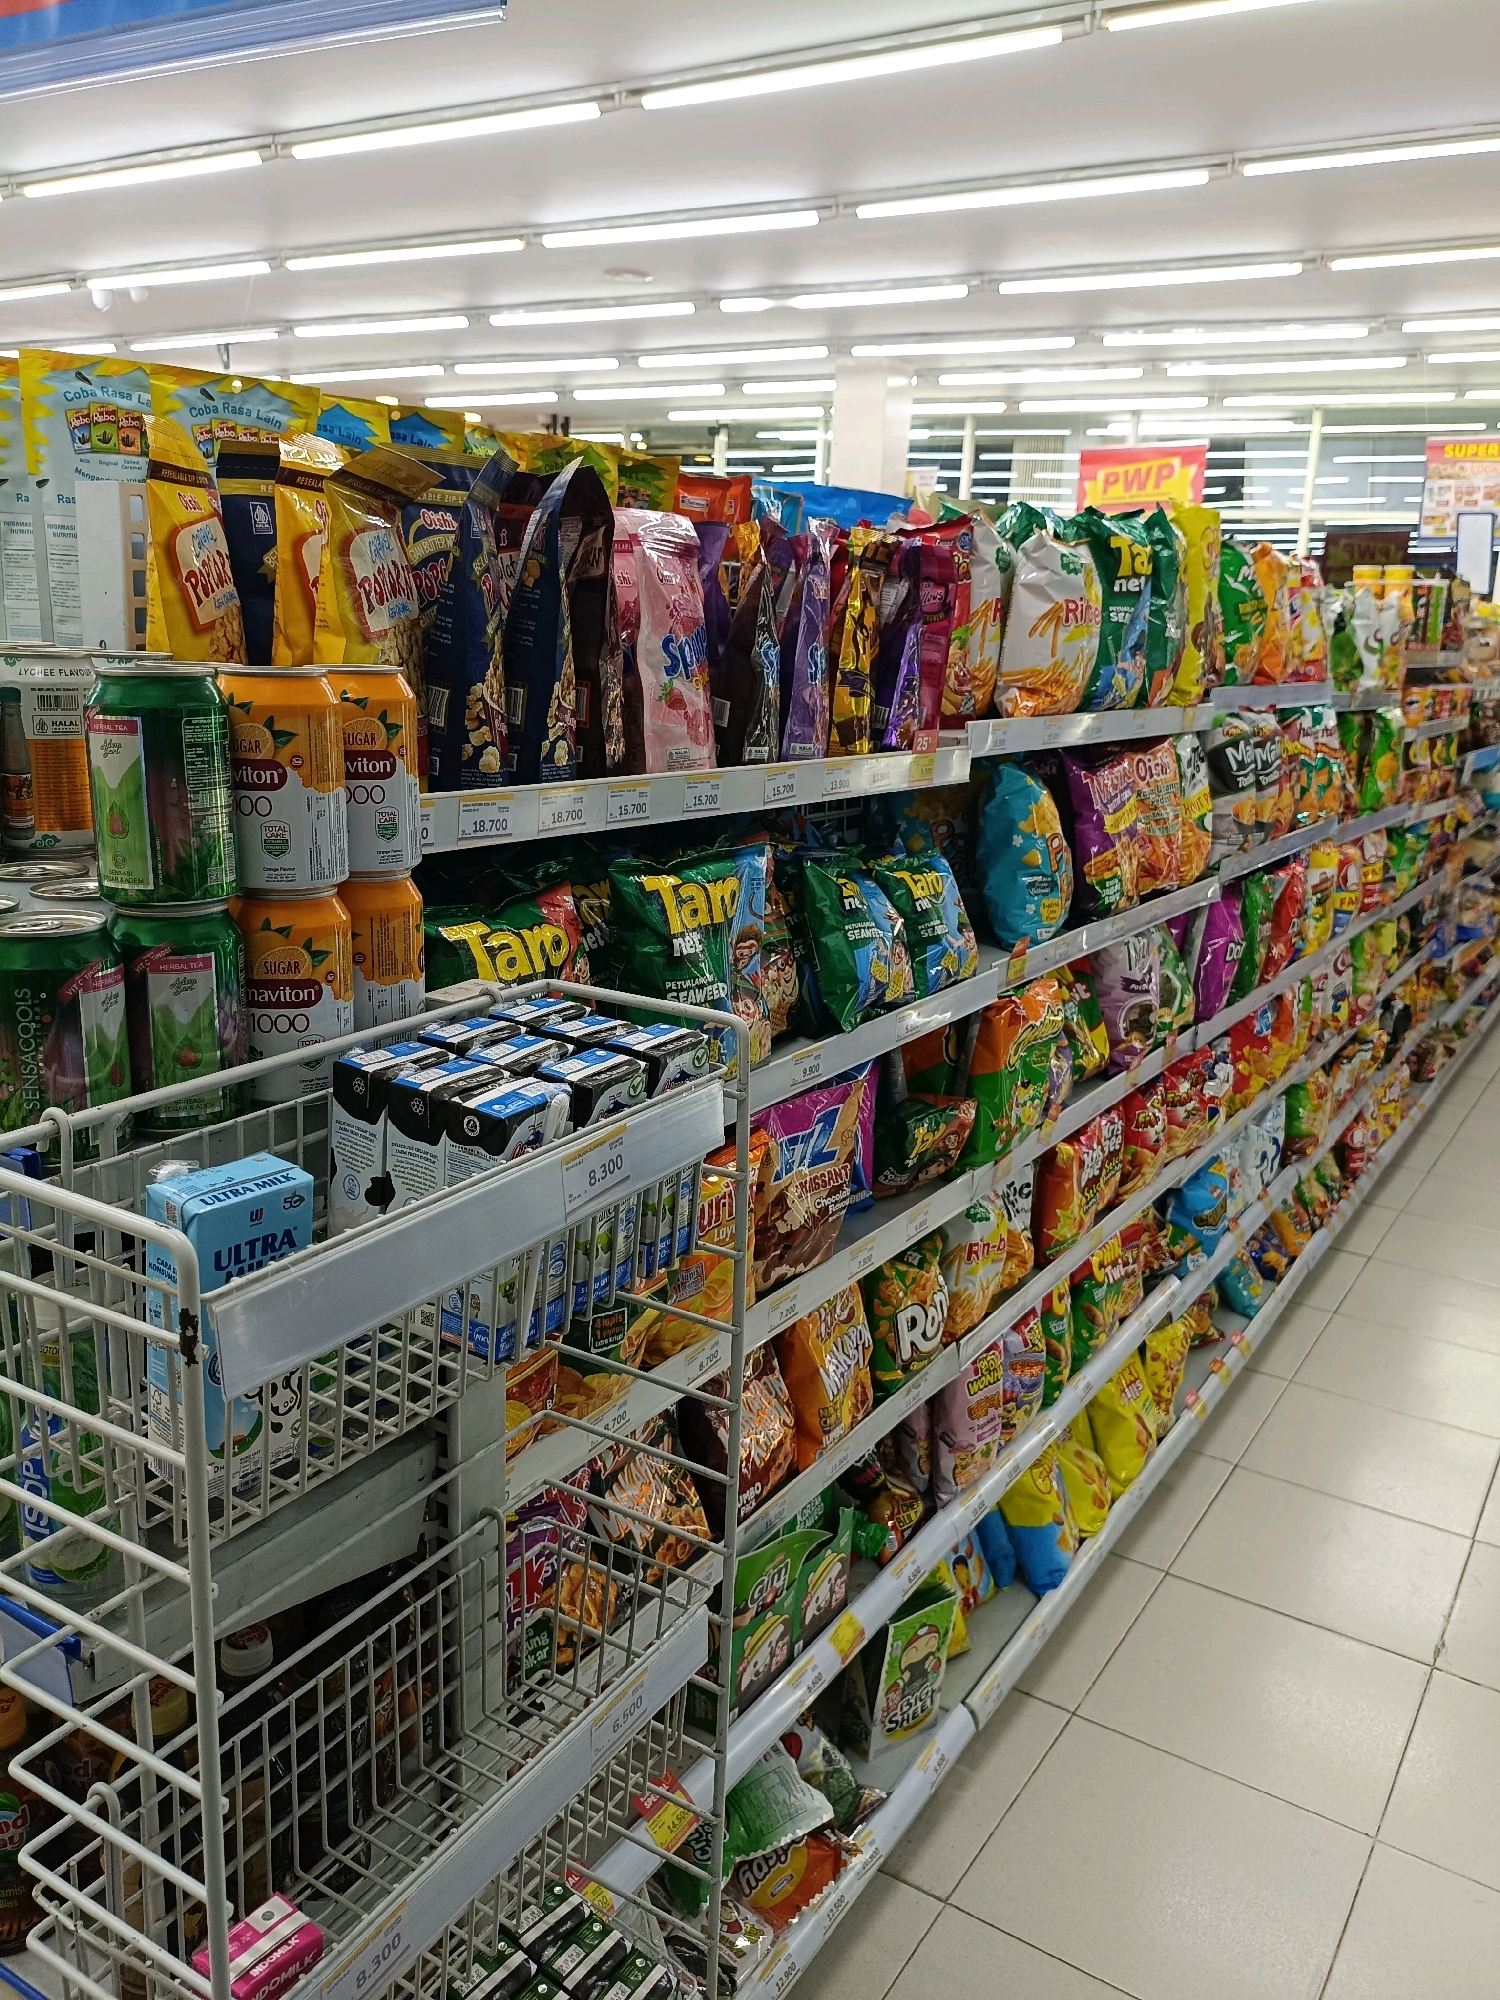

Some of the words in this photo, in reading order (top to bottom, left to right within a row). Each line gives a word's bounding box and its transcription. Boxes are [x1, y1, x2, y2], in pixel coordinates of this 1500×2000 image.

[64, 388, 97, 403] Coba
[101, 386, 133, 402] Rasa
[92, 411, 116, 424] Rebo
[118, 415, 140, 428] Rebo
[189, 405, 218, 418] Coba
[223, 402, 252, 418] Rasa
[256, 409, 282, 430] Lain
[214, 428, 235, 439] Rebo
[1444, 443, 1499, 458] SUPER
[1102, 463, 1174, 496] PWP
[444, 494, 457, 503] ZIP
[421, 509, 456, 530] Oishi
[19, 668, 55, 677] LYCHEE
[58, 668, 92, 677] FLAVOUR
[93, 724, 115, 732] HERBAL
[772, 783, 794, 797] 15.700
[830, 779, 850, 792] 13.900
[692, 794, 718, 808] 15.700
[551, 808, 583, 825] 18.700
[618, 803, 648, 820] 15.700
[263, 825, 288, 833] TOTAL
[472, 818, 508, 834] 18.700
[896, 870, 944, 899] Taro
[643, 876, 740, 935] Taro
[438, 921, 569, 983] Taro
[673, 932, 703, 957] net
[134, 962, 146, 973] VIT
[145, 958, 151, 966] C
[150, 947, 172, 964] TINGGI
[159, 963, 188, 971] HERBAL
[189, 961, 204, 969] TEA
[263, 960, 301, 975] SUGAR
[66, 984, 78, 996] VIT
[78, 978, 85, 986] C
[666, 982, 727, 1005] SEAWEED
[250, 1013, 310, 1034] 1000
[802, 1064, 820, 1077] 9.900
[588, 1153, 624, 1187] 8.300
[200, 1186, 253, 1206] ULTRA
[253, 1173, 297, 1191] MILK
[214, 1228, 298, 1272] ULTRA
[156, 1257, 172, 1271] CARA
[778, 1303, 797, 1321] 7.200
[595, 1319, 602, 1329] 4
[602, 1314, 623, 1327] lapis
[596, 1329, 601, 1340] 1
[608, 1333, 624, 1345] Krispi
[698, 1348, 719, 1371] 8.700
[900, 1685, 936, 1713] BIG
[612, 1694, 643, 1734] 6.500
[885, 1701, 935, 1734] SHEET
[827, 1894, 846, 1921] 12.500
[249, 1933, 300, 1977] INDOMILK
[355, 1932, 401, 1990] 8.300
[774, 1961, 798, 1992] 12.900
